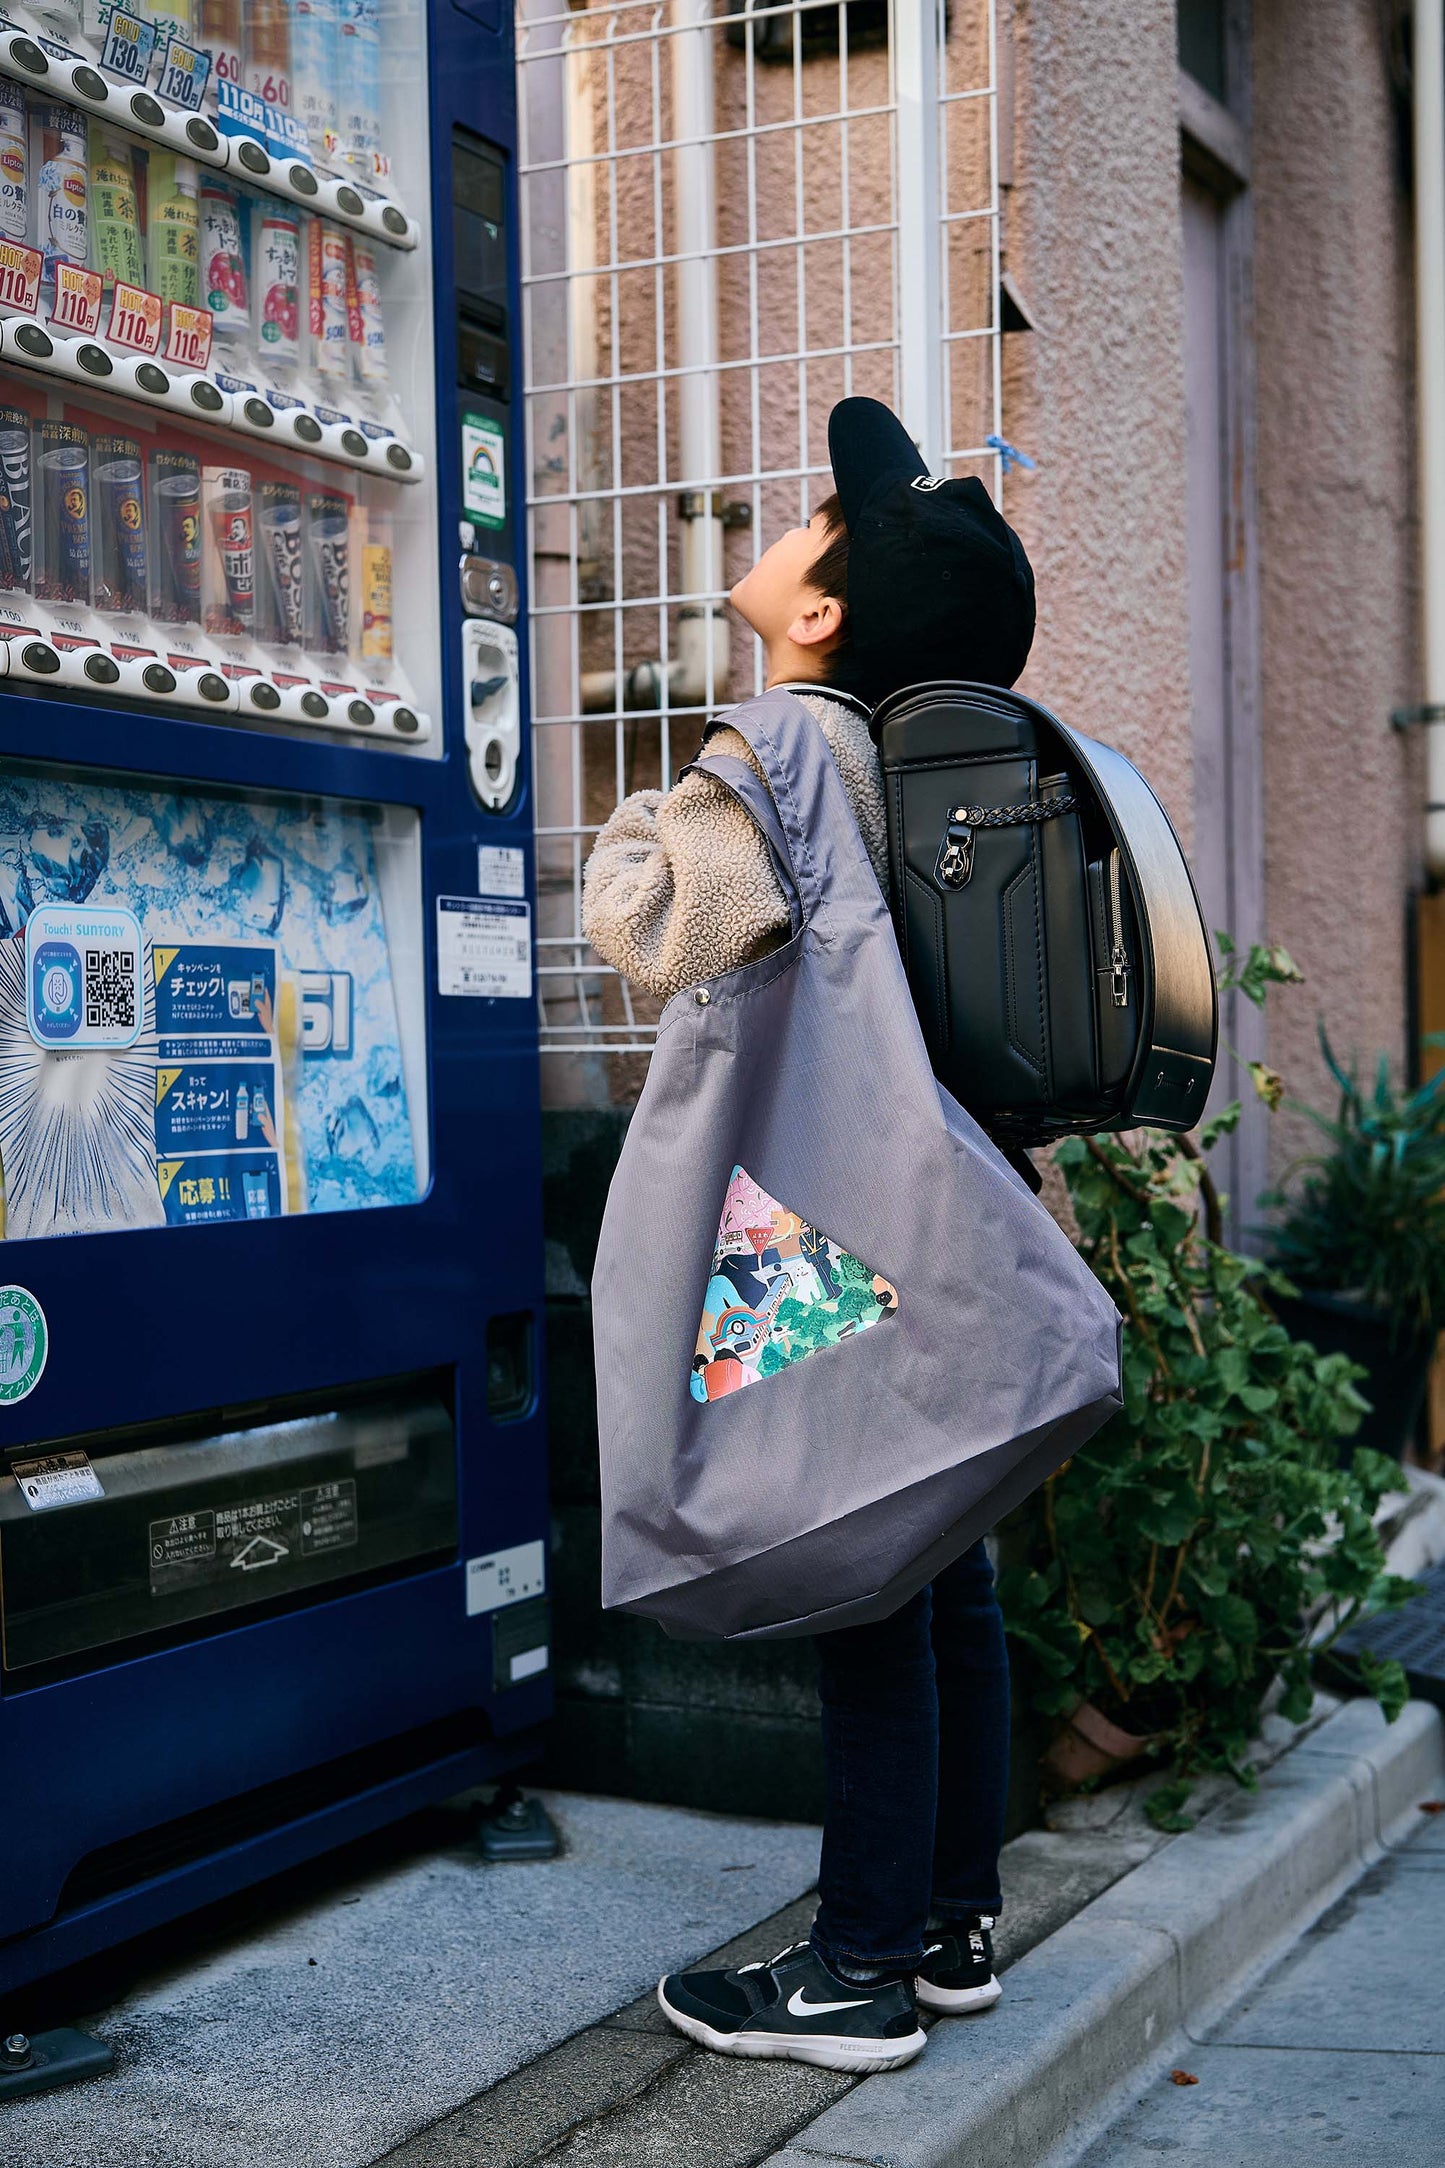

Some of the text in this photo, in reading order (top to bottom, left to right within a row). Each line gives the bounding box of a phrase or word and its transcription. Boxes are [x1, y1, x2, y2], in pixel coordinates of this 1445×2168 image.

[114, 15, 140, 43] COLD
[109, 36, 144, 78] 130円
[171, 46, 195, 73] COLD
[166, 66, 199, 107] 130円
[119, 196, 134, 220] 茶
[1, 244, 23, 270] HOT
[182, 233, 197, 257] 茶
[62, 268, 84, 293] HOT
[61, 290, 95, 329] 110円
[120, 289, 142, 313] HOT
[117, 310, 154, 349] 110円
[176, 309, 195, 331] HOT
[43, 923, 73, 935] Touch!
[160, 954, 164, 966] 1
[177, 963, 222, 974] キャンペーンを
[170, 977, 226, 998] チェック!
[162, 1075, 167, 1087] 2
[171, 1089, 230, 1112] スキャン!
[163, 1168, 169, 1180] 3
[179, 1515, 197, 1532] 注意
